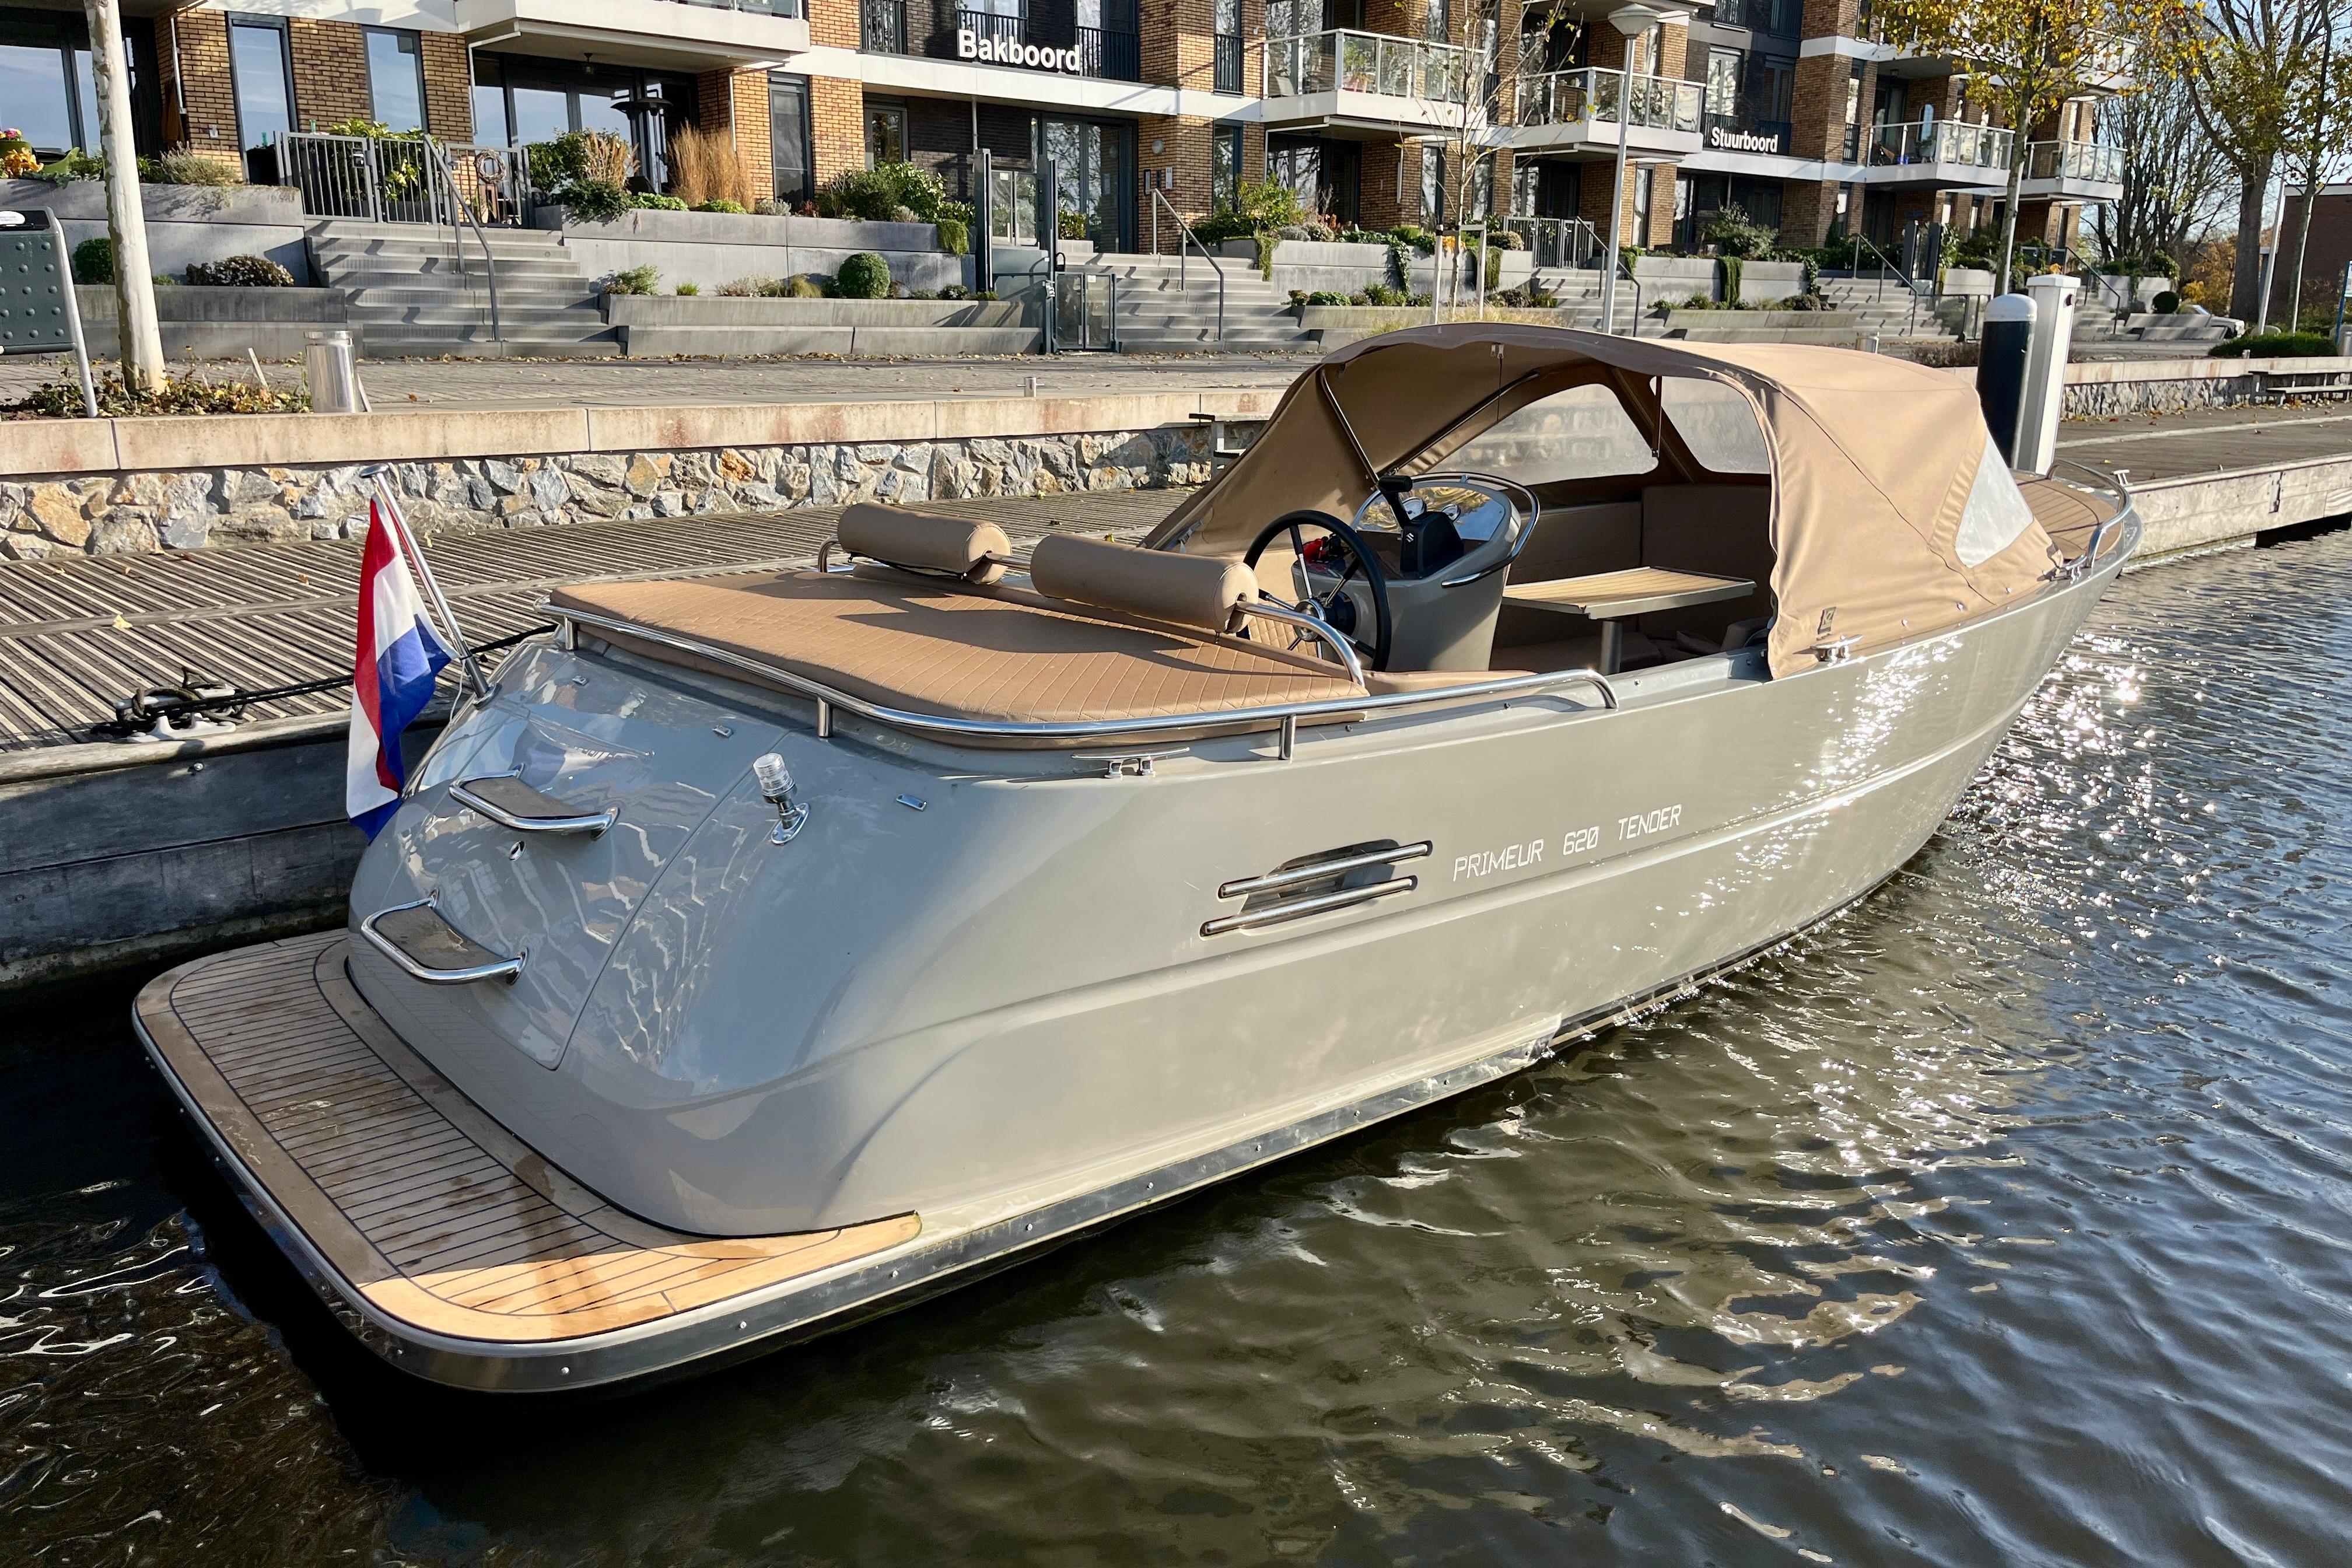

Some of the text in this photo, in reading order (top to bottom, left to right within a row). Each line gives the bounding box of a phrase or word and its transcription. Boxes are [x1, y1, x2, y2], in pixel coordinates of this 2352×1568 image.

[958, 29, 1080, 71] Bakboord
[1711, 127, 1778, 153] Stuurboord
[1452, 804, 1682, 882] PRIMEUR 620 TENDER
